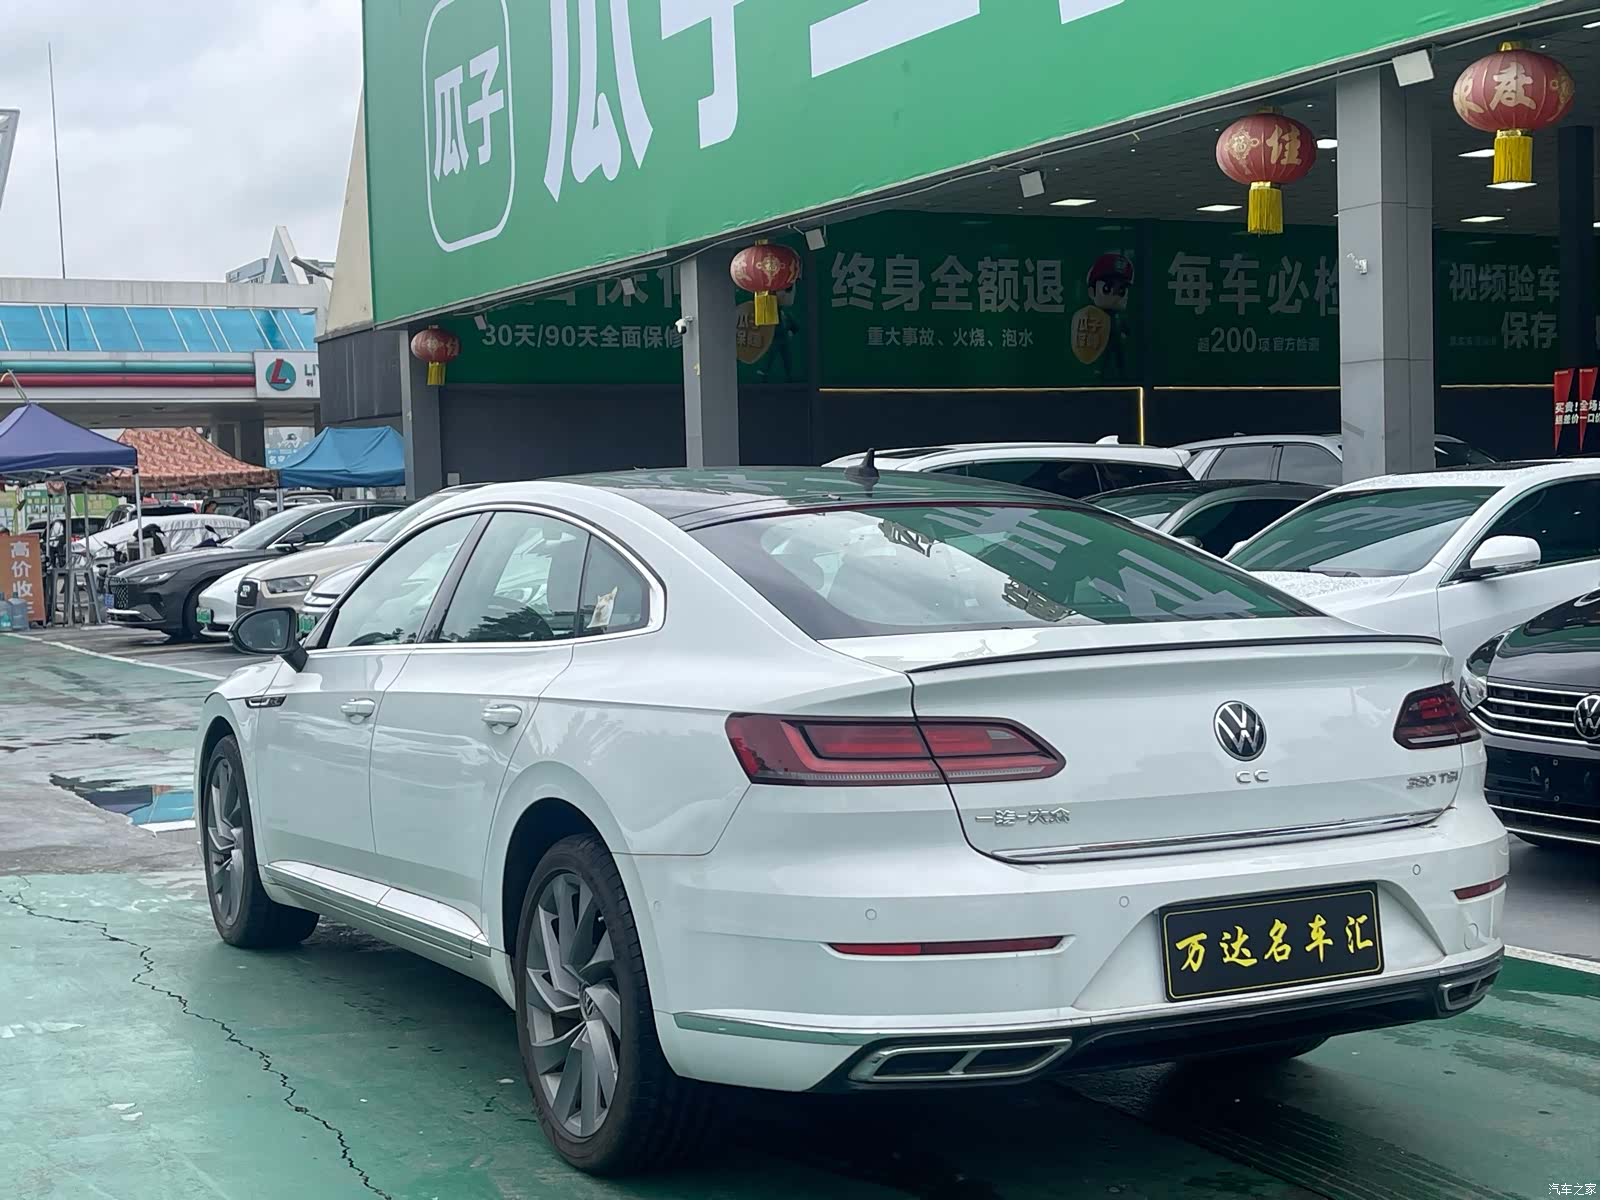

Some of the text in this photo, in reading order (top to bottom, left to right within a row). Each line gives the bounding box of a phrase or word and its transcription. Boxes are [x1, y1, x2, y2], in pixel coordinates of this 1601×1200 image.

[433, 45, 505, 183] 瓜子
[1266, 123, 1303, 165] 佳
[830, 251, 1066, 314] 终身全额退
[1449, 263, 1560, 303] 视频验车
[481, 323, 683, 350] 30天/90天全面保修
[866, 326, 1034, 348] 重大事故、火烧、泡水
[1501, 310, 1558, 349] 保存
[1579, 399, 1601, 411] 全场
[1235, 768, 1270, 785] CC
[1438, 770, 1459, 785] TSI
[1175, 913, 1375, 973] 万达名车汇
